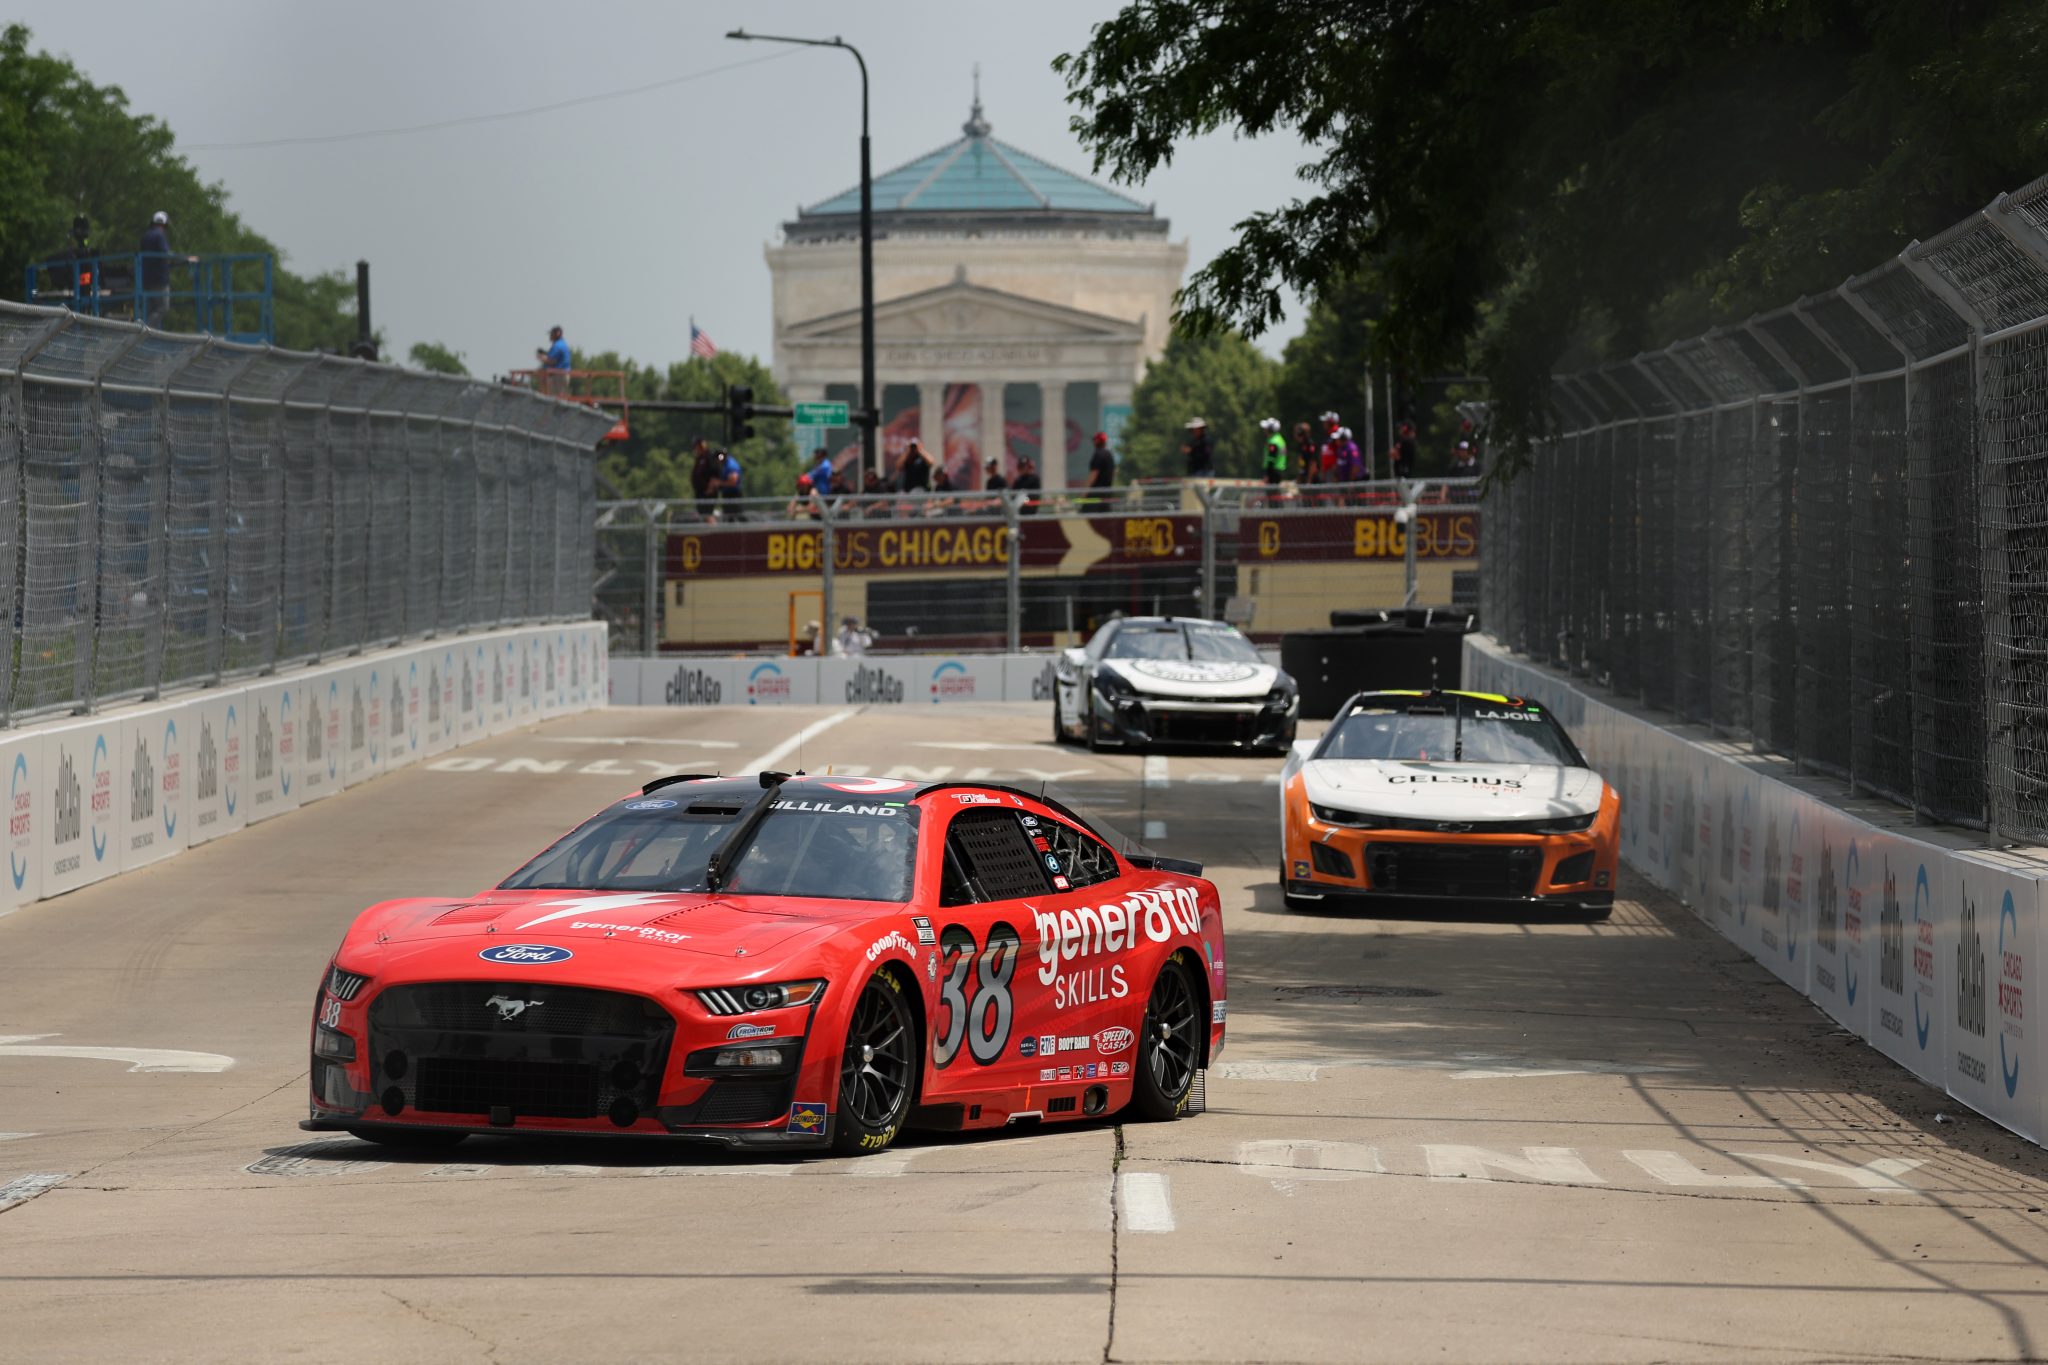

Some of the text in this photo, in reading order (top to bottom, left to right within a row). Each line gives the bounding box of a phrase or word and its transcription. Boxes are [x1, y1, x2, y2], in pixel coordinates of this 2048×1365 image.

[879, 526, 1009, 566] CHICAGO
[1475, 710, 1542, 722] LAJOIE
[426, 756, 720, 775] ONLY
[1388, 775, 1523, 788] CELSIUS
[569, 920, 692, 941] gener8tor
[638, 934, 681, 945] SKILLS
[1037, 886, 1201, 986] gener8tor
[495, 946, 556, 961] Ford
[1917, 947, 1934, 981] SPORTS
[2004, 950, 2023, 982] CHICAGO
[934, 920, 1022, 1068] 38
[1055, 964, 1130, 1010] SKILLS
[322, 998, 341, 1028] 38
[2004, 984, 2023, 1021] SPORTS
[1058, 1037, 1074, 1051] BOOT
[1074, 1035, 1090, 1049] BARN
[1103, 1030, 1132, 1042] SPEEDY
[792, 1114, 823, 1124] SUNOCO
[860, 1125, 896, 1148] EAGLE
